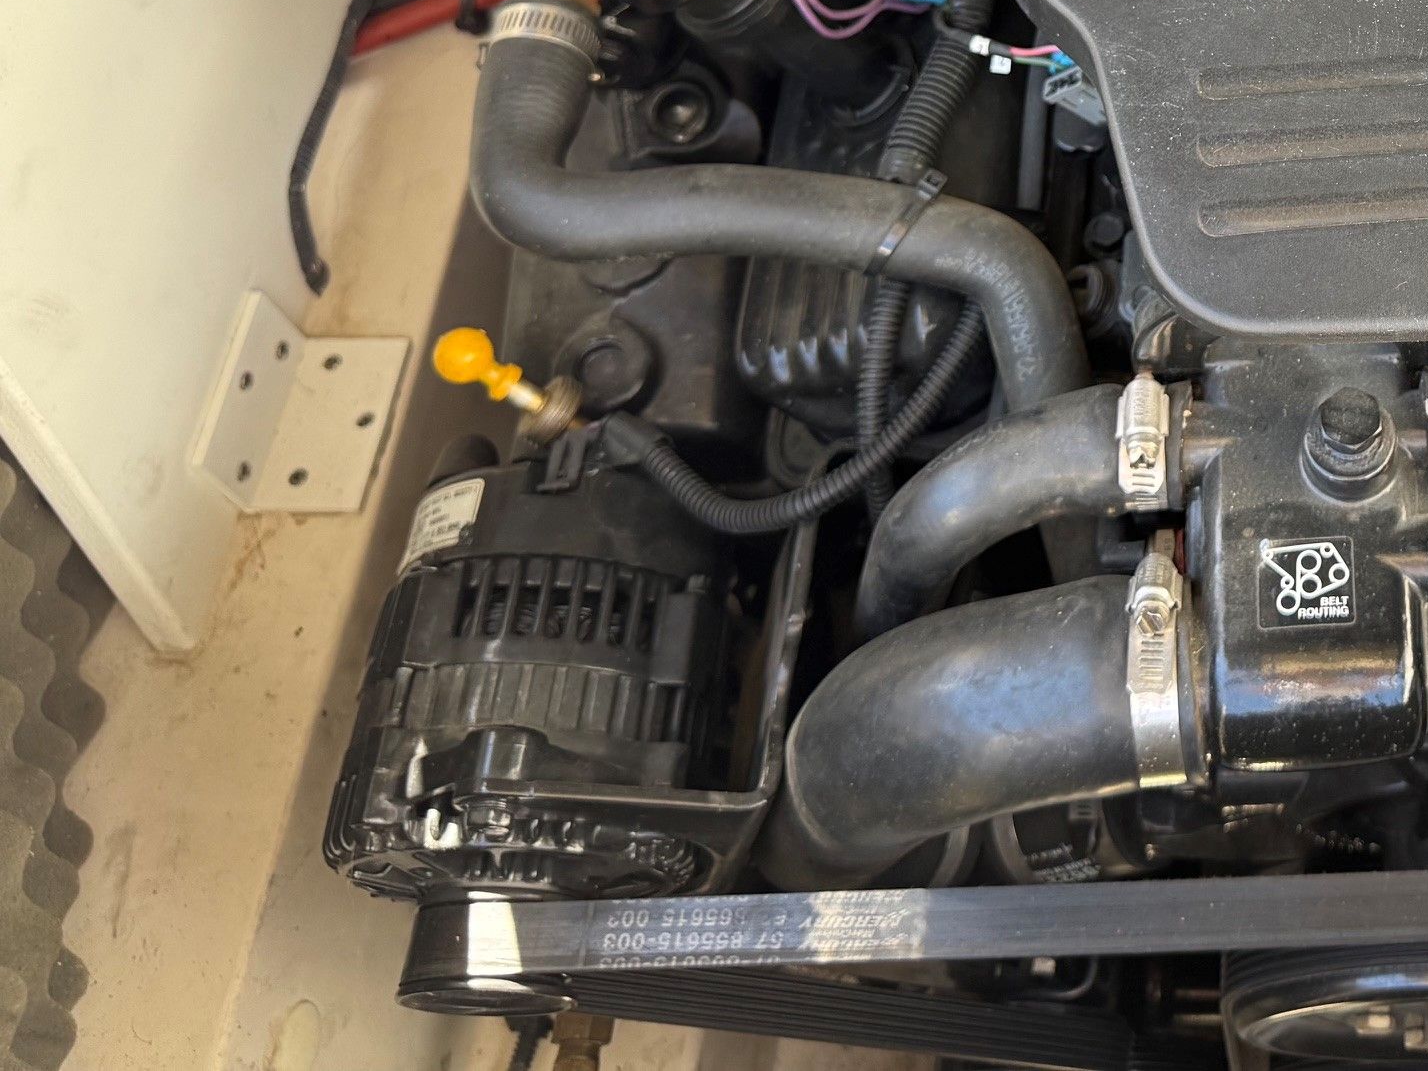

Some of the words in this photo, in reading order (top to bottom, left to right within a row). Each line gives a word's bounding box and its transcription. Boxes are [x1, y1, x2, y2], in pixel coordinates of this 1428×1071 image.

[1320, 596, 1349, 607] BELT
[1297, 607, 1349, 619] ROUTING
[799, 910, 908, 929] MERCURY
[755, 931, 785, 950] 57
